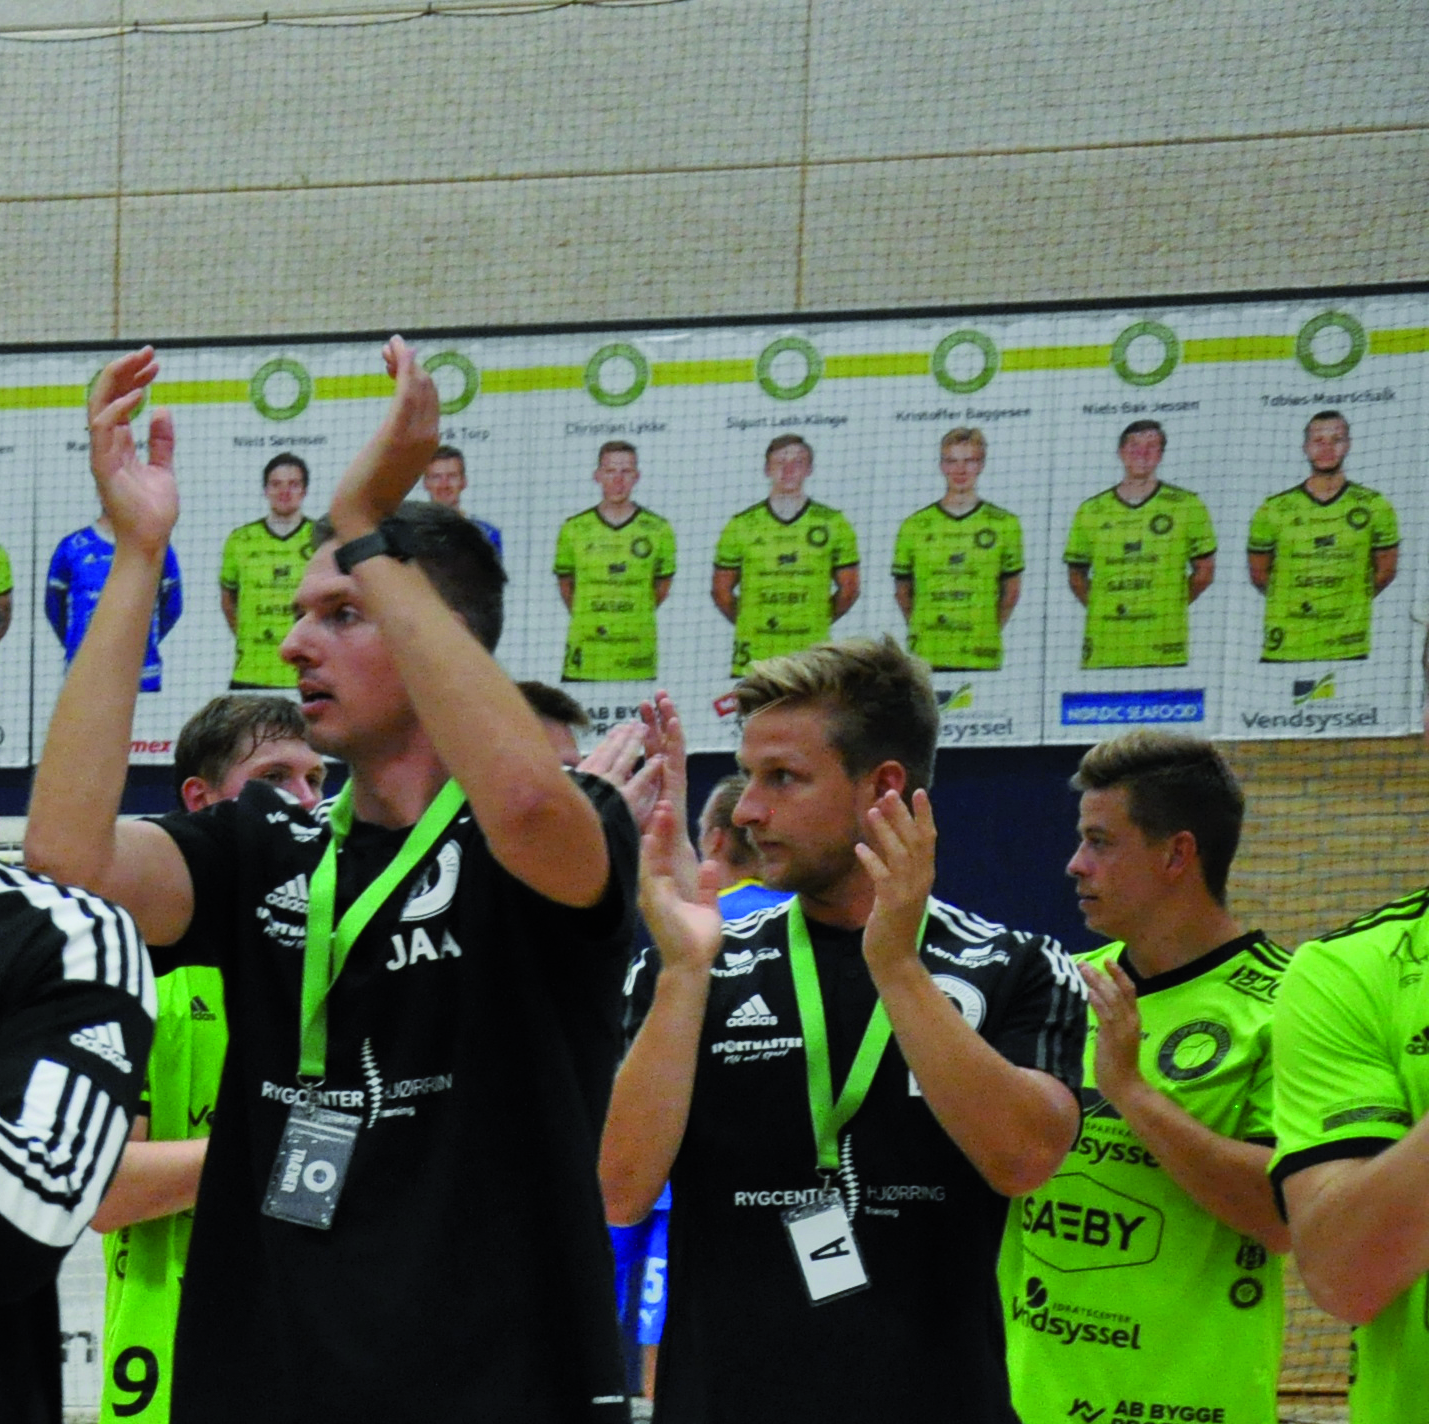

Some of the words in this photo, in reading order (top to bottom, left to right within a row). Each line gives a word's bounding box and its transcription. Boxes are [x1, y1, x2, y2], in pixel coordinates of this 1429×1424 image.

[1068, 705, 1124, 722] NORDIC
[1126, 704, 1198, 722] SEAFOOD
[1242, 707, 1378, 731] Vendsyssel
[726, 1015, 779, 1028] adidas
[644, 1257, 668, 1303] 5
[1012, 1294, 1142, 1350] Vndsyssel
[111, 1345, 160, 1418] 9
[1113, 1399, 1145, 1417] AB
[1150, 1401, 1226, 1424] BYGGE
